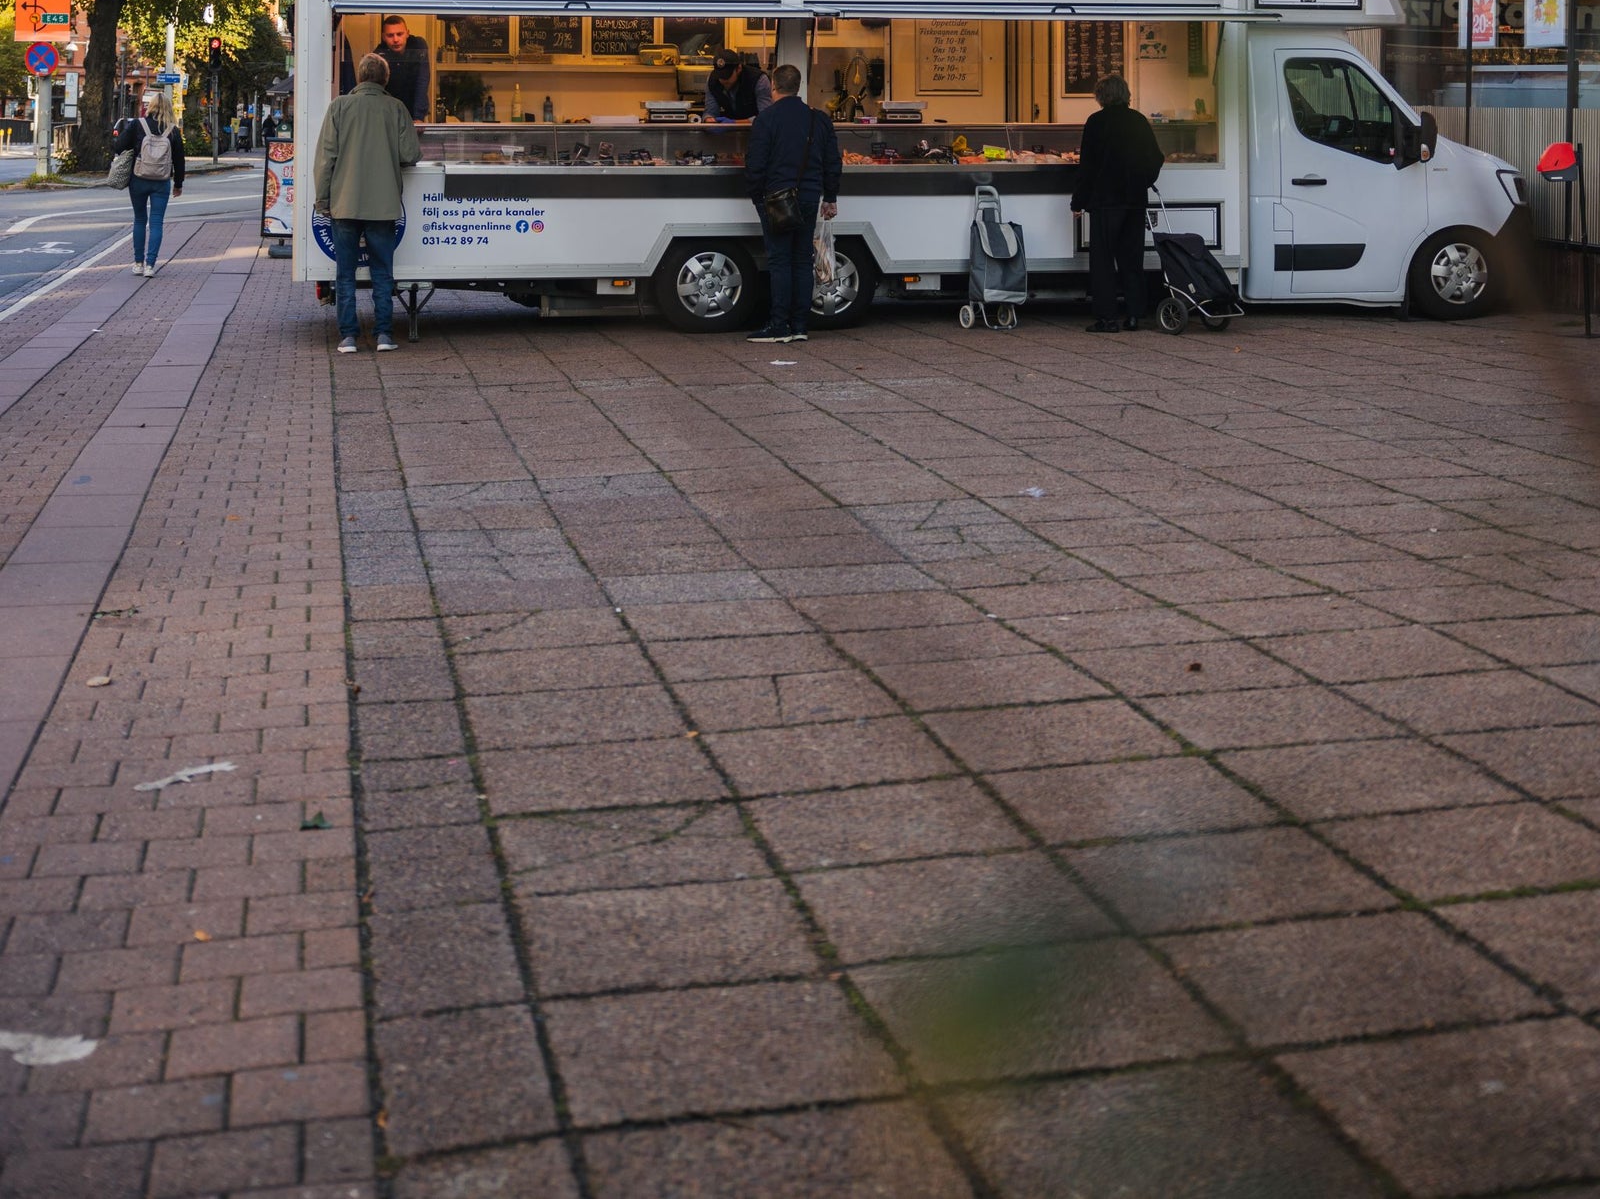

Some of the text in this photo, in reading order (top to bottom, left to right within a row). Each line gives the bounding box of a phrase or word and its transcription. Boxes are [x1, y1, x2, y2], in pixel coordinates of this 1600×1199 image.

[423, 193, 444, 202] Håll
[422, 207, 440, 218] följ
[462, 207, 476, 218] på
[479, 207, 502, 216] våra
[505, 207, 545, 216] kanaler
[422, 221, 512, 233] @fiskvagnenlinne
[319, 228, 337, 255] HAVE
[422, 236, 489, 245] 031-42 89 74
